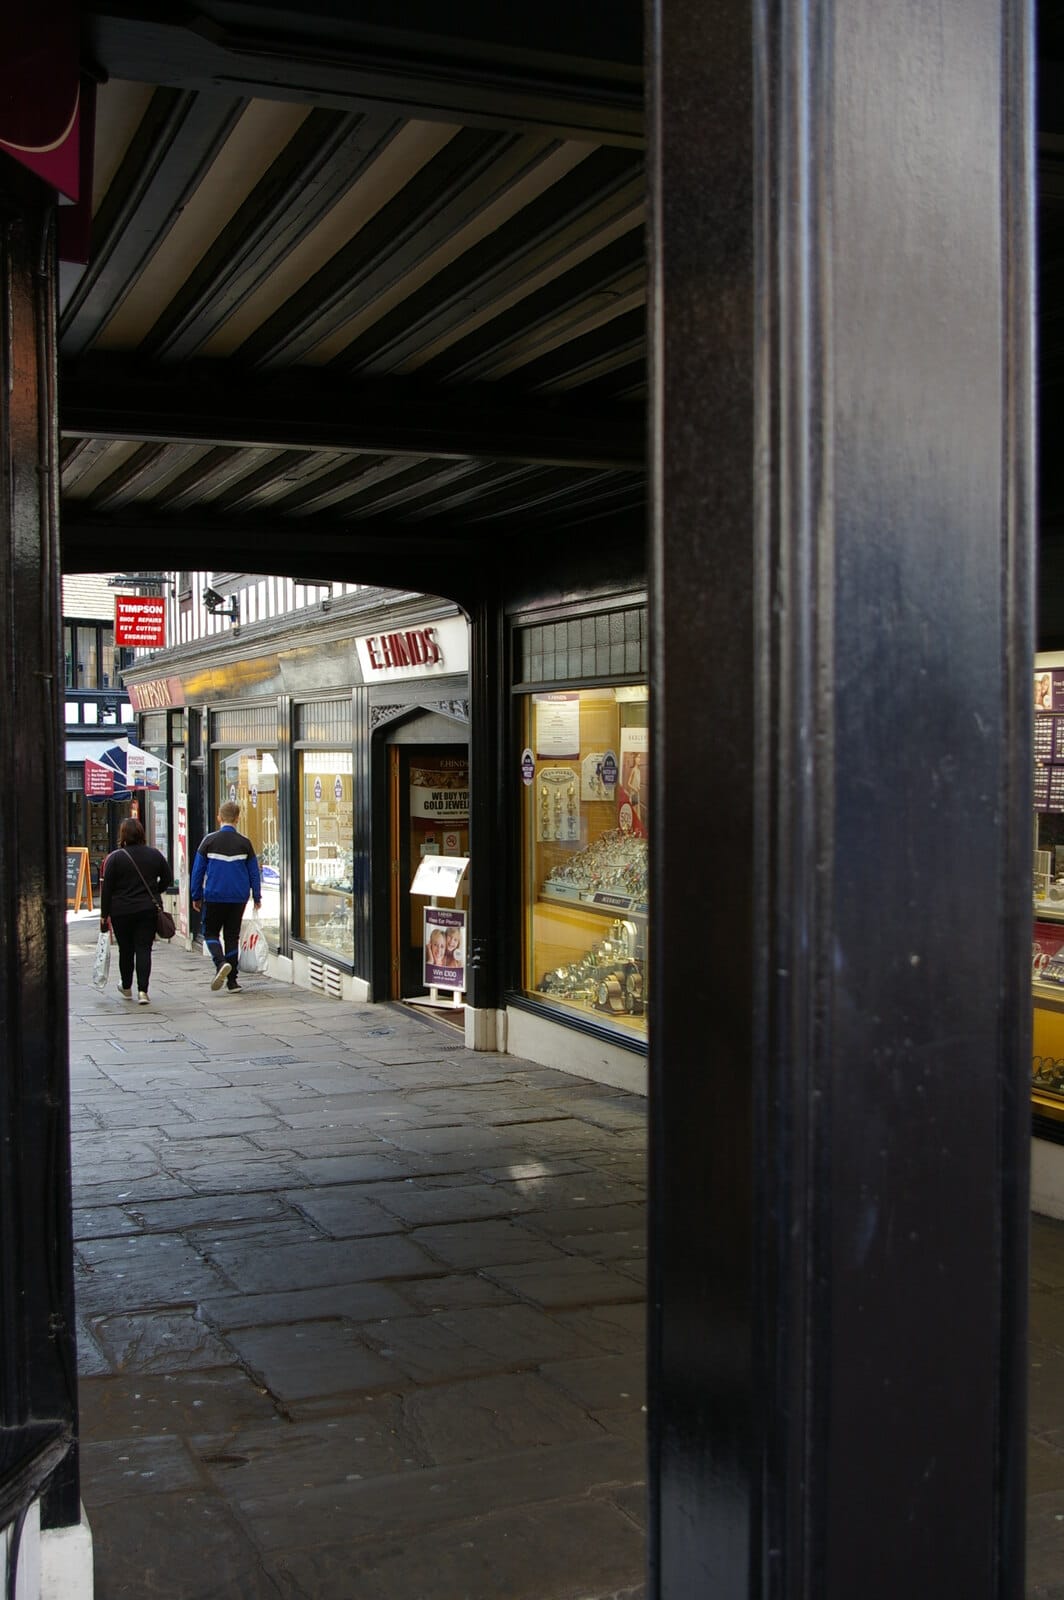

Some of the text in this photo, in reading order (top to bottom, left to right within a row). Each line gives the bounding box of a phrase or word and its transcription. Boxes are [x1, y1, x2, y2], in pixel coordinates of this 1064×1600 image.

[118, 604, 163, 614] TIMPSON
[133, 680, 172, 708] TIMPSON
[432, 792, 442, 800] WE
[444, 792, 457, 800] BUY
[424, 801, 443, 810] GOLD
